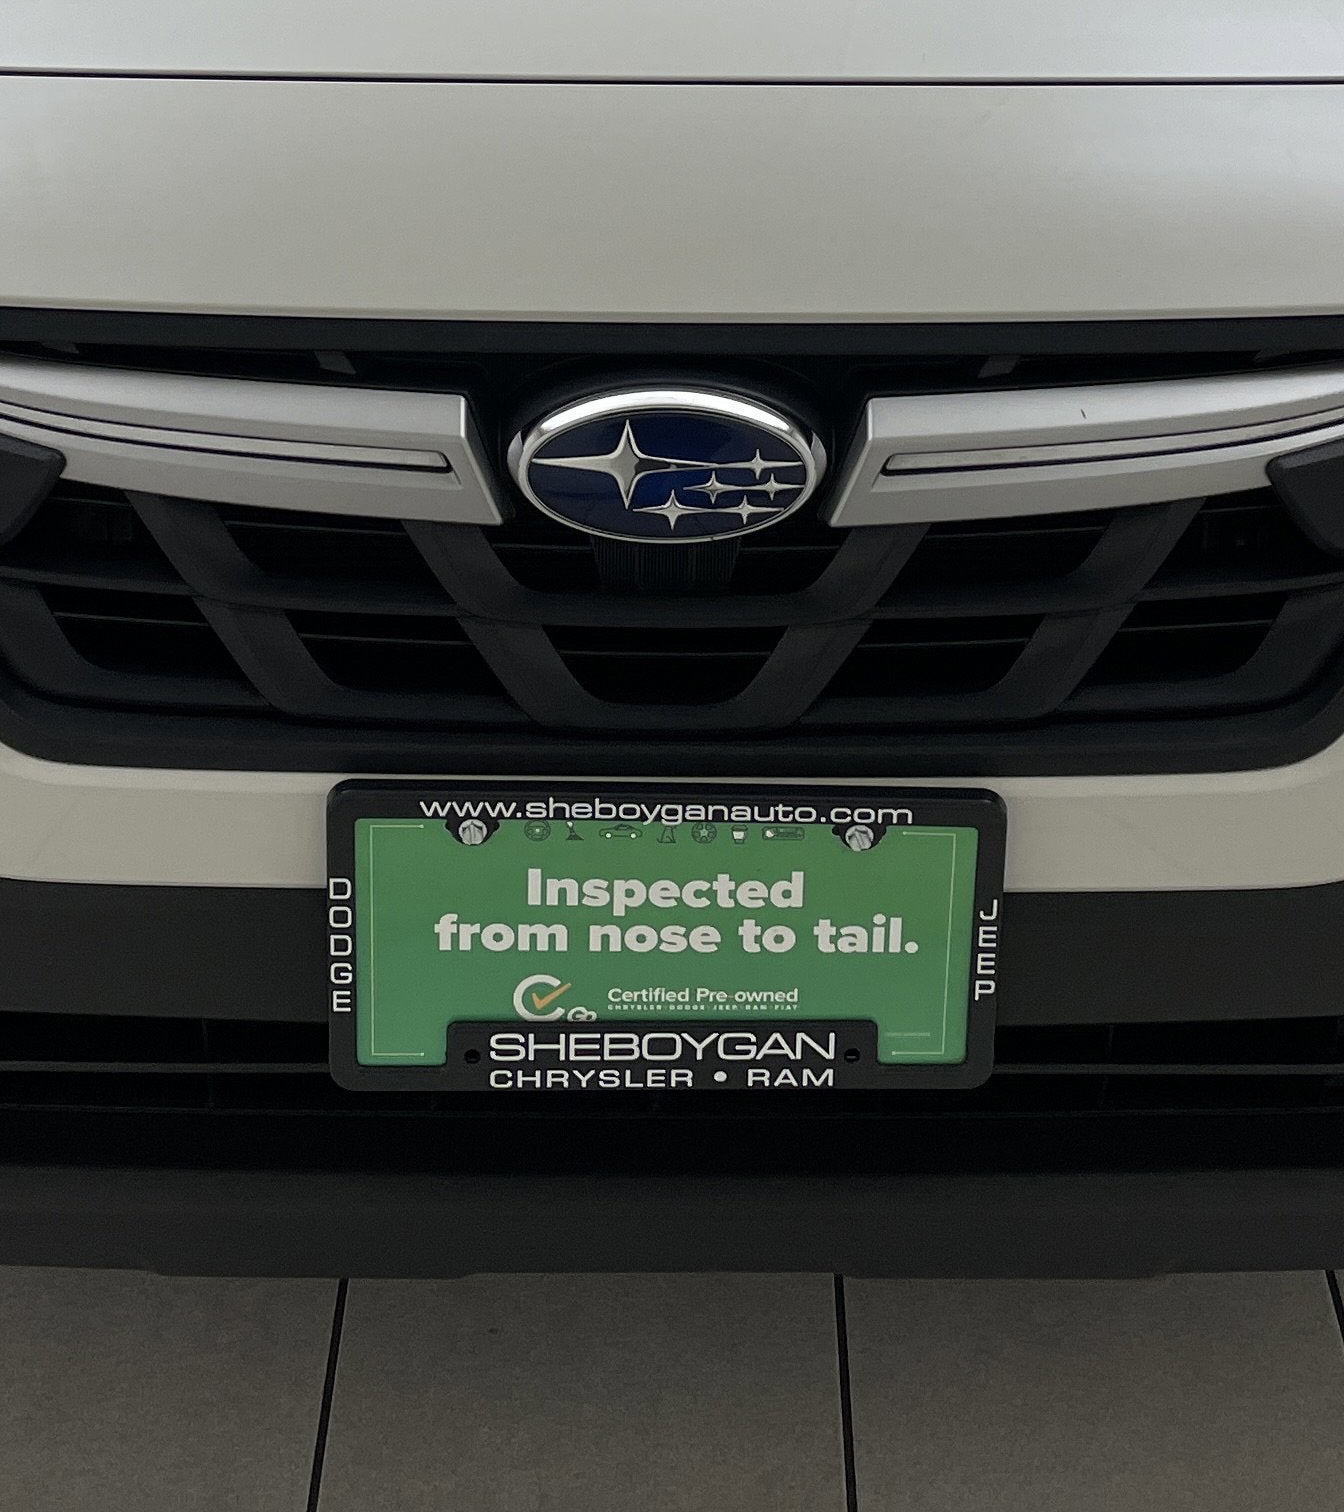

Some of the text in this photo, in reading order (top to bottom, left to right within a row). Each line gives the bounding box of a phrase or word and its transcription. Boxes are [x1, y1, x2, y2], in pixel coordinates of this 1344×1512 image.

[419, 797, 914, 827] www.sheboyganauto.com
[528, 868, 805, 916] Inspected
[328, 877, 354, 1013] DODGE
[434, 913, 919, 954] from nose to tail.
[974, 899, 999, 1001] JEEP
[607, 987, 799, 1003] Certified Pre-owned
[489, 1032, 836, 1063] SHEBOYGAN
[489, 1068, 835, 1090] CHRYSLER RAM
